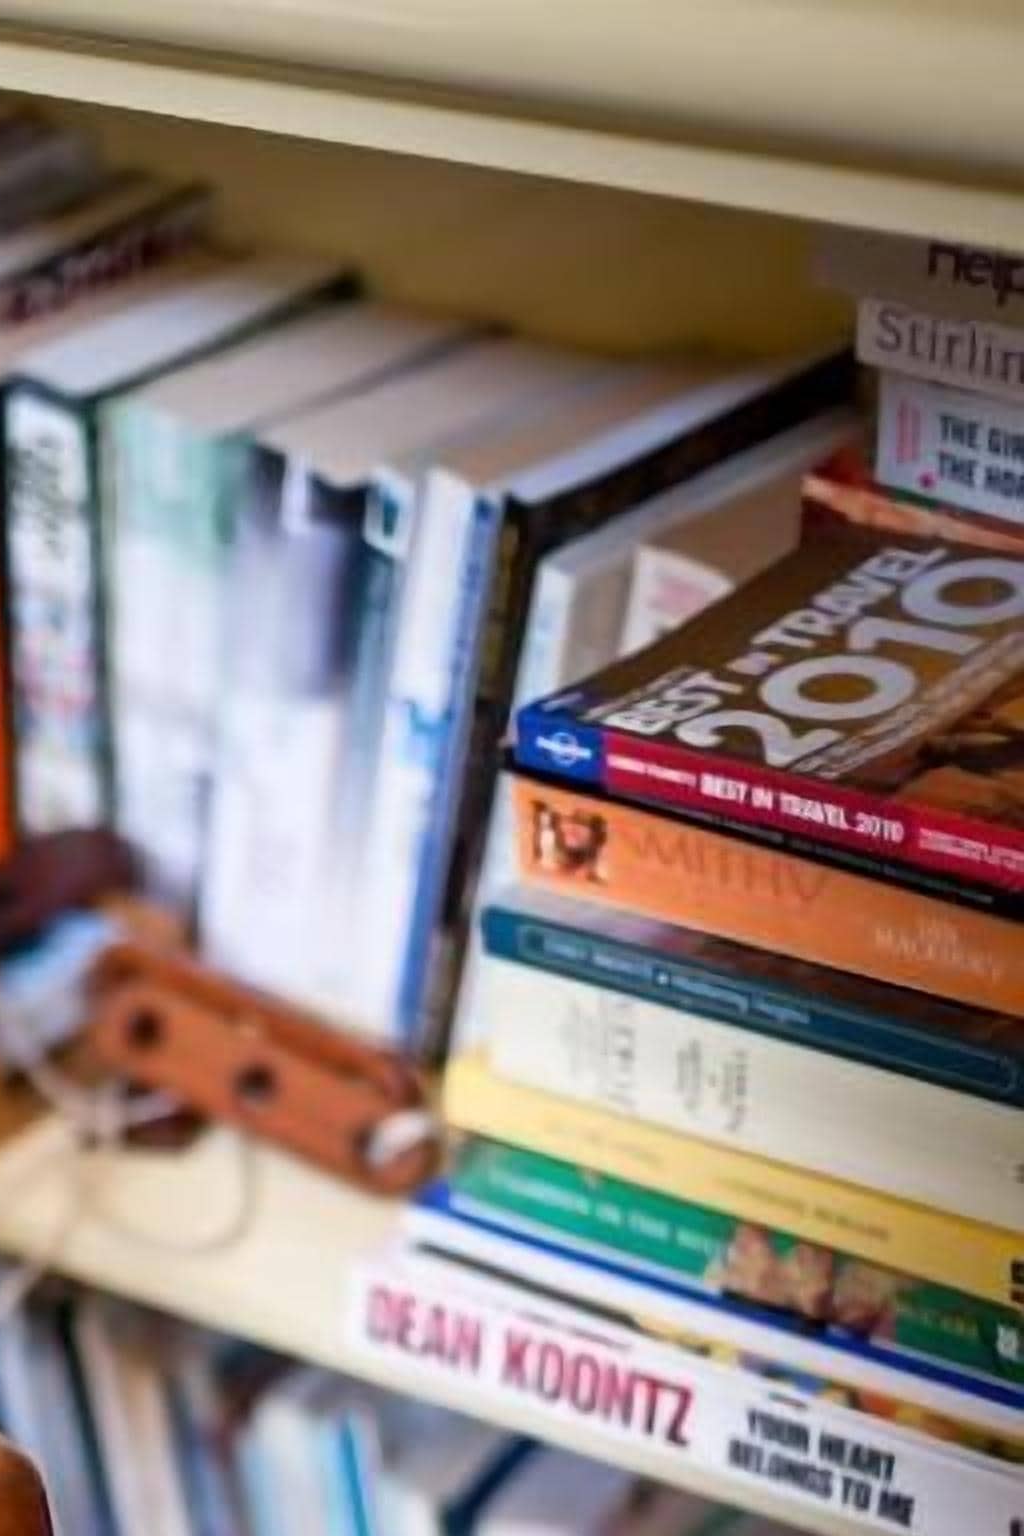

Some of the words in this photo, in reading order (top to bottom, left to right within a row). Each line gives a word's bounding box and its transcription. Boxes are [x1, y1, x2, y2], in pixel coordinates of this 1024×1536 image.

[750, 547, 949, 648] TRAVEL
[675, 557, 1024, 768] 2010
[699, 772, 749, 805] BEST
[750, 786, 775, 812] IN
[778, 790, 849, 831] TRAVEL
[854, 811, 906, 844] 2010
[367, 1285, 481, 1374] DEAN
[501, 1324, 694, 1447] KOONTZ
[728, 1438, 833, 1500] BELONGS
[842, 1475, 872, 1512] TO
[878, 1489, 915, 1528] ME
[748, 1408, 810, 1454] YOUR
[818, 1430, 895, 1483] HEART
